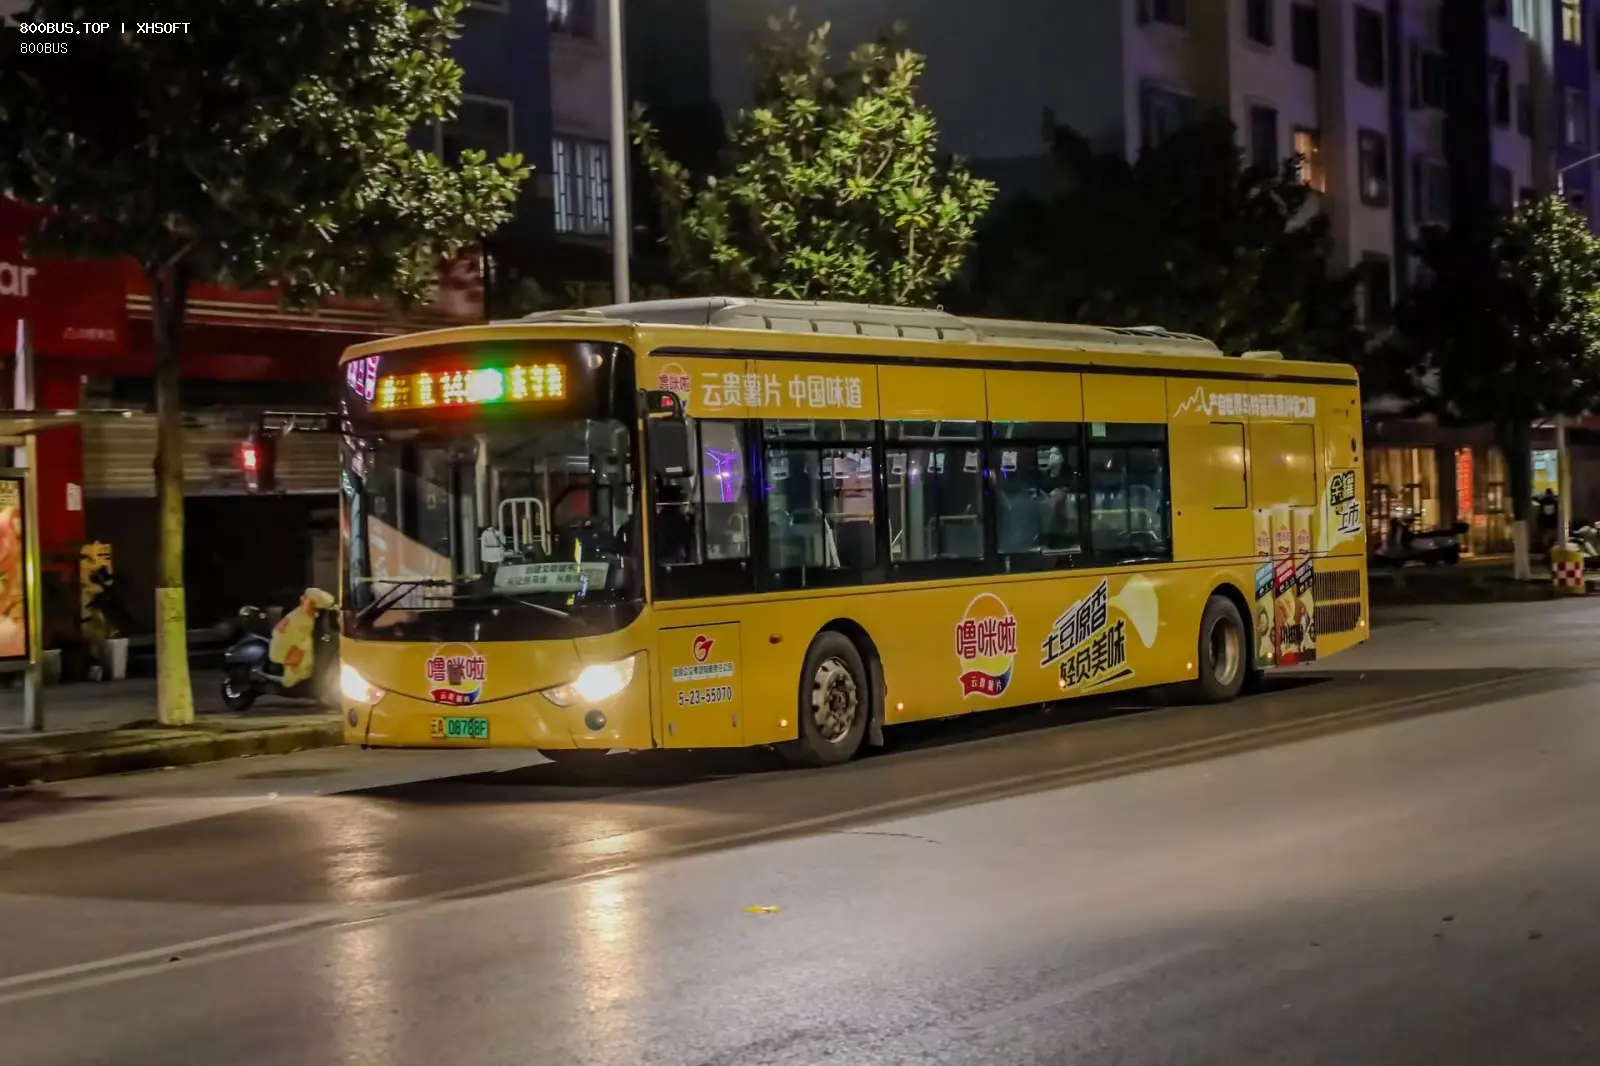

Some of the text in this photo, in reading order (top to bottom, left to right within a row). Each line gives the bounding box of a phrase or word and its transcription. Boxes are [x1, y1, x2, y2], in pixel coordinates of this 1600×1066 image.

[701, 372, 863, 409] 云贵薯片 中国味道
[956, 616, 1017, 660] 噜咪啦
[678, 686, 732, 706] 5-23-55070
